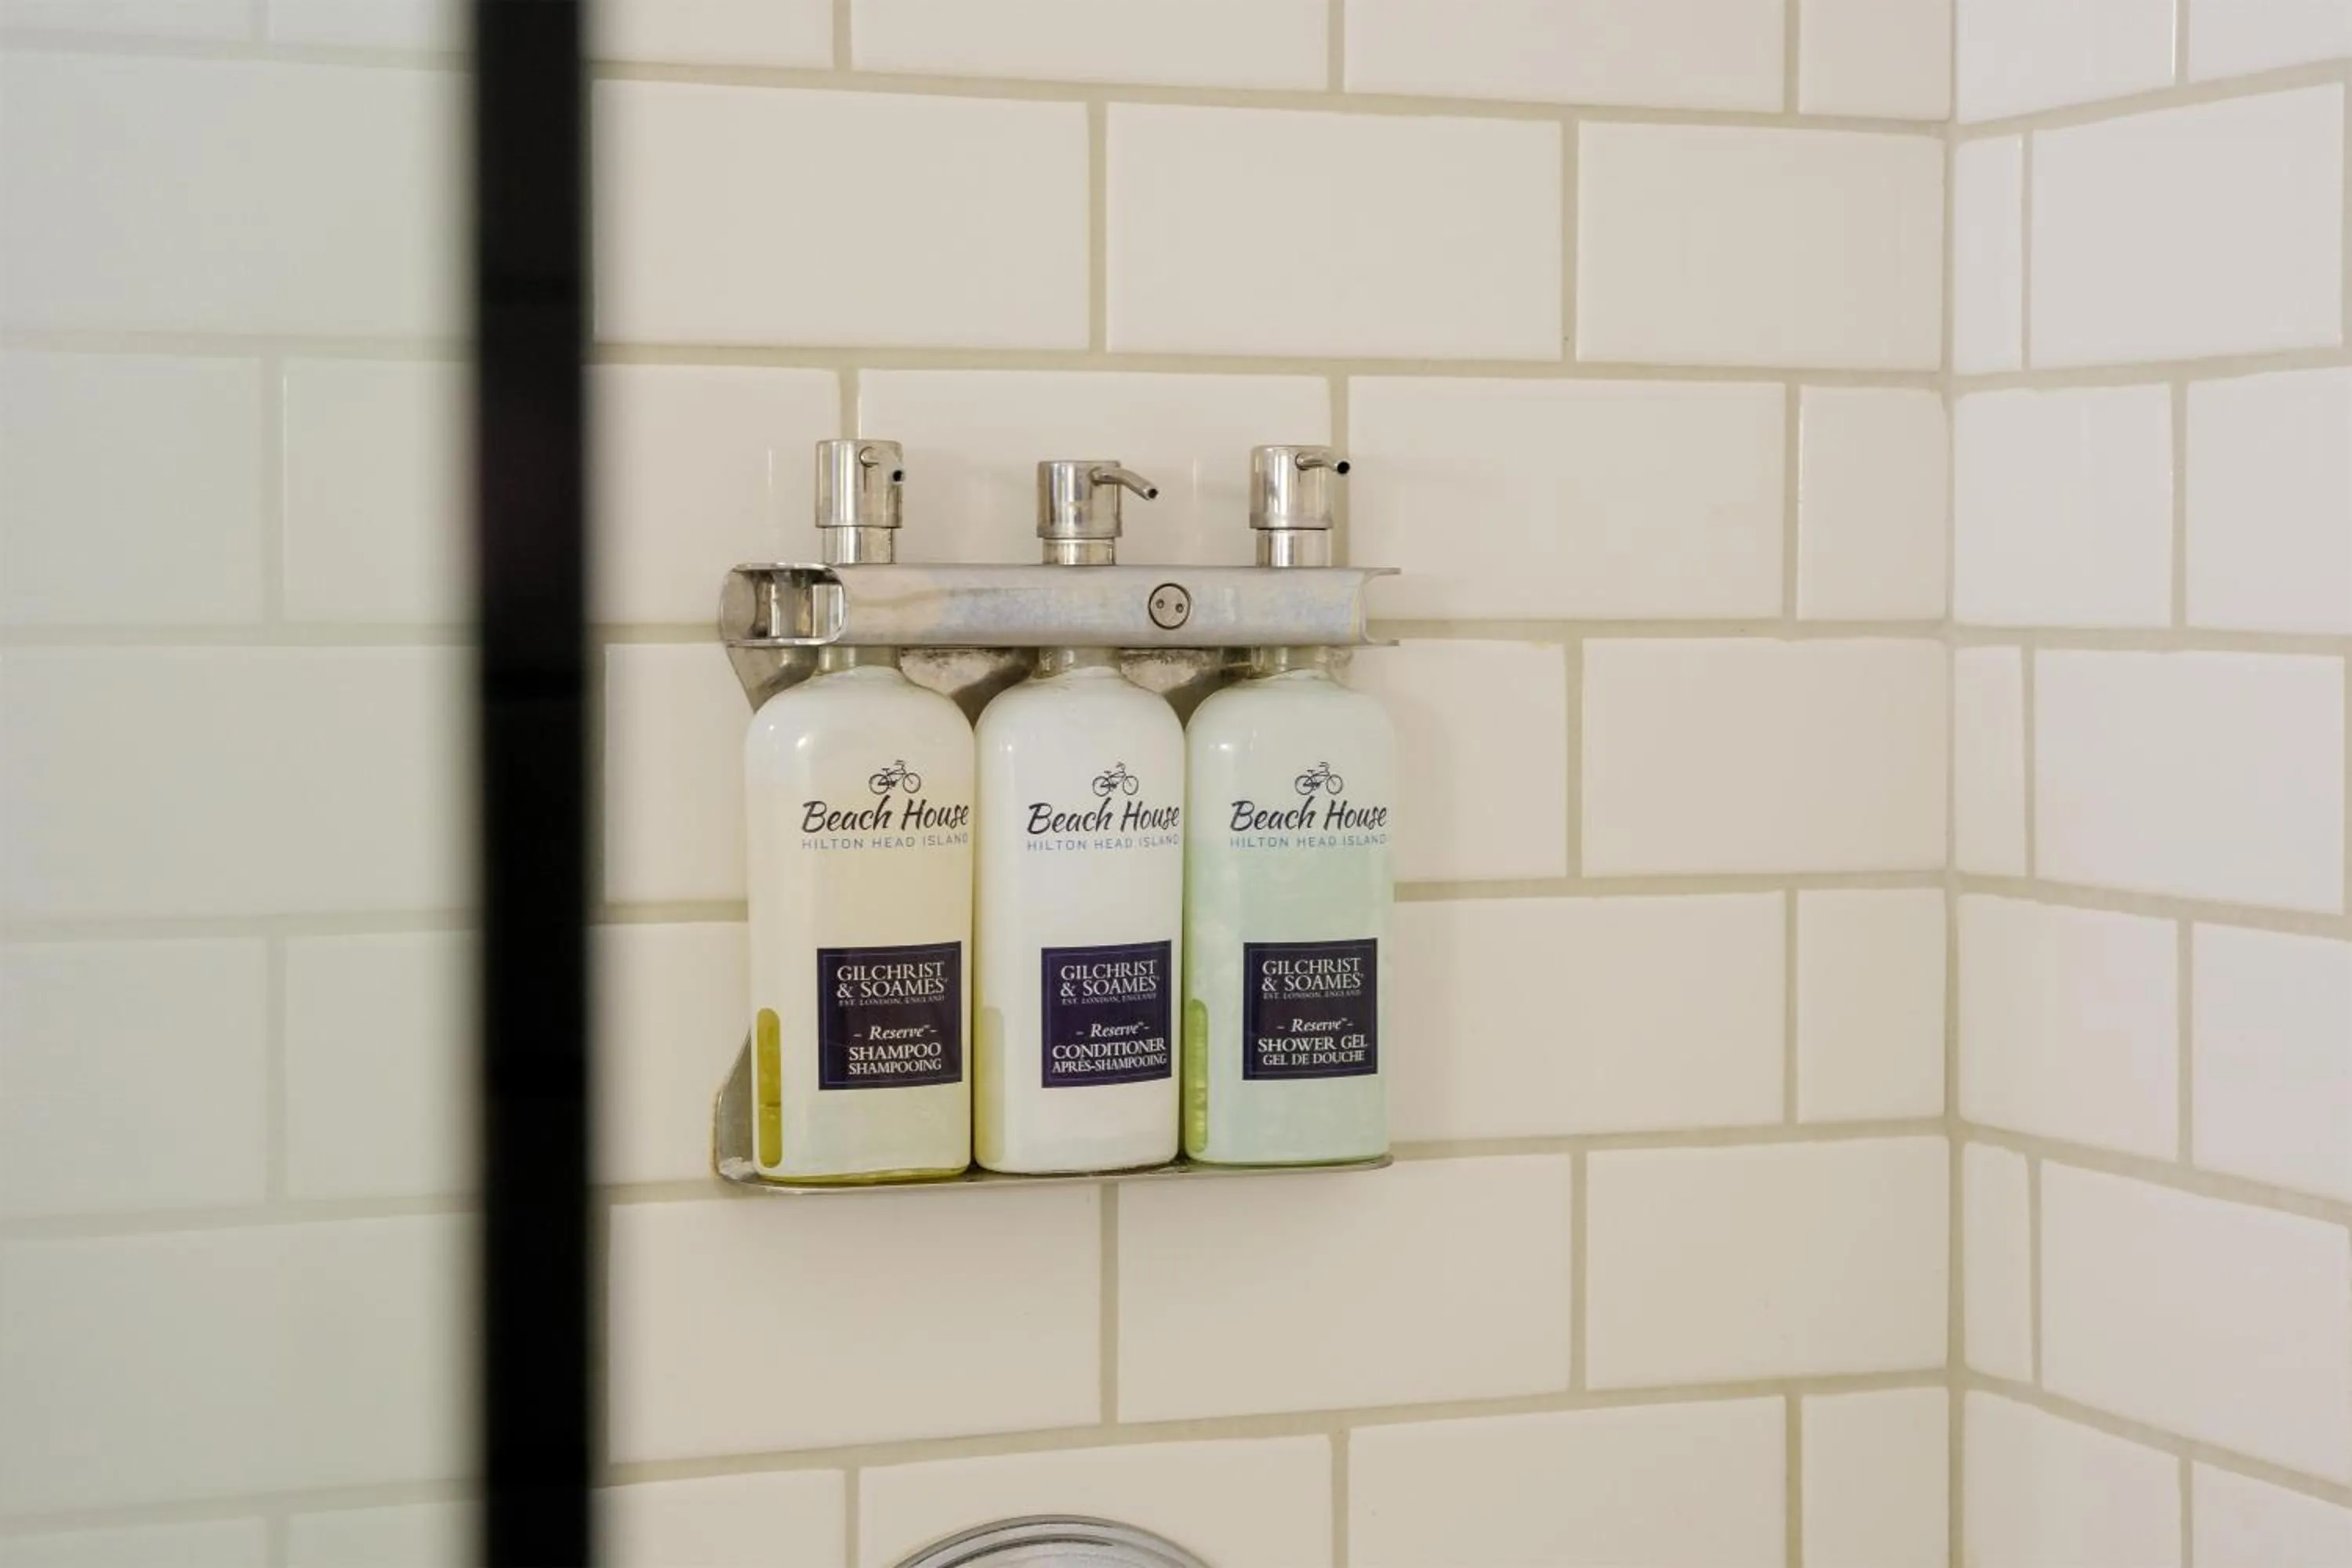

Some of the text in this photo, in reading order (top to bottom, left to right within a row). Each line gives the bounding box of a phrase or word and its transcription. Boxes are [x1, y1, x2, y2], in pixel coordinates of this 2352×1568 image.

[801, 794, 969, 833] Beach House
[1026, 797, 1180, 834] Beach House
[1229, 795, 1387, 831] Beach House
[801, 833, 969, 850] HILTON HEAD ISLAND
[1027, 834, 1179, 851] HILTON HEAD ISLAND
[1230, 833, 1387, 848] HILTON HEAD ISLAND
[837, 962, 945, 981] GILCHRIST
[1060, 960, 1157, 980] GILCHRIST
[1261, 957, 1362, 975] GILCHRIST
[837, 978, 946, 998] & SOAMES
[1060, 975, 1156, 997] & SOAMES
[1261, 972, 1361, 992] & SOAMES
[848, 1042, 941, 1061] SHAMPOO
[1052, 1037, 1167, 1059] CONDITIONER
[1258, 1034, 1368, 1053] SHOWER GEL
[848, 1058, 942, 1075] SHAMPOOING
[1263, 1050, 1365, 1065] GEL DE DOUCHE
